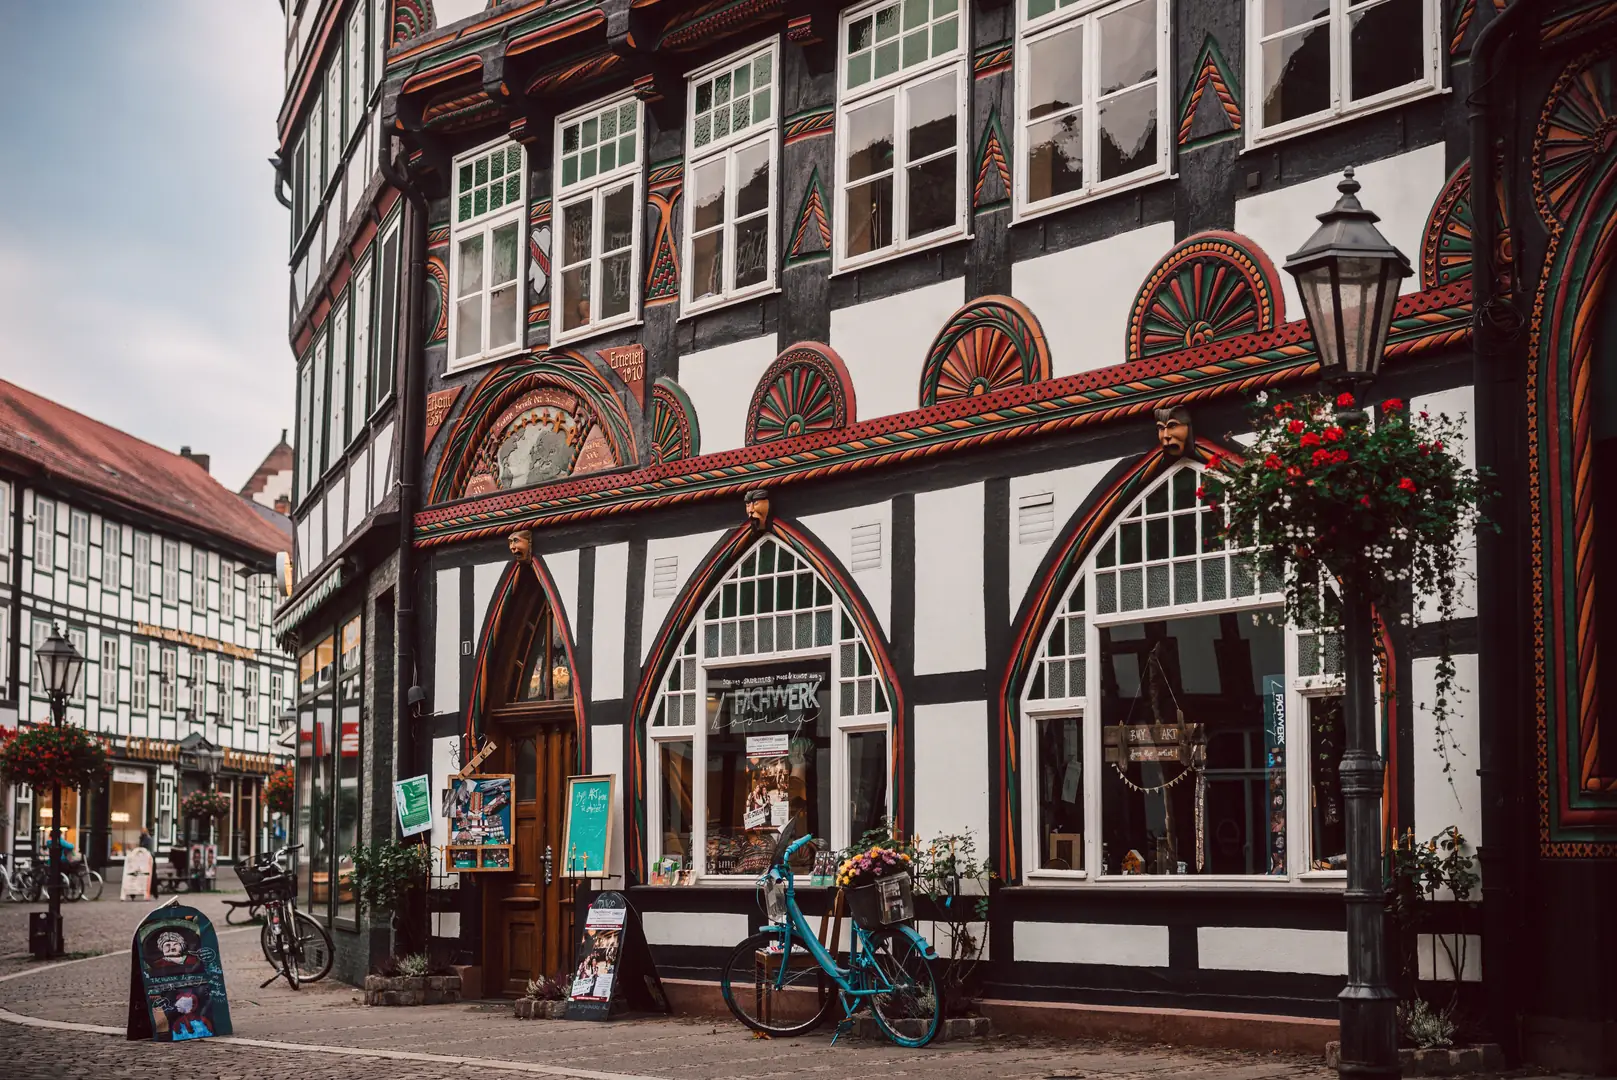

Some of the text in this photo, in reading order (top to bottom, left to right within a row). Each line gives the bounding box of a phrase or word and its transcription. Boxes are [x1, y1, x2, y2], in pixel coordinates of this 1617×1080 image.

[622, 365, 643, 383] 1910
[734, 682, 821, 714] FACHWERK
[711, 692, 822, 743] hooray
[1275, 693, 1285, 745] FACHWERK
[1130, 728, 1178, 741] BUY ART
